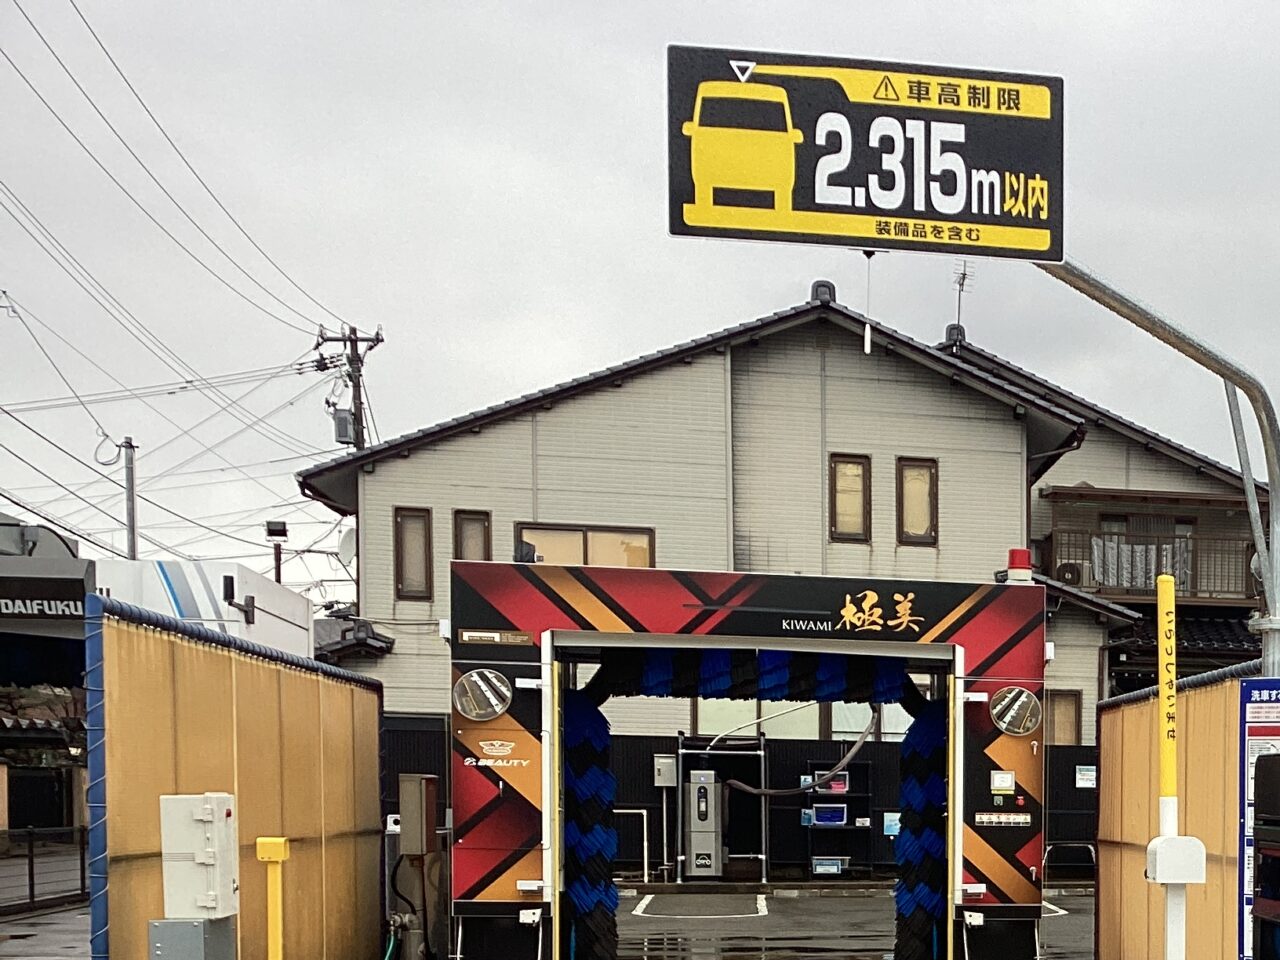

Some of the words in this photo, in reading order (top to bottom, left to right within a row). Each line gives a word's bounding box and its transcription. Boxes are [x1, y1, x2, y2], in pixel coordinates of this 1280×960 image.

[907, 79, 1021, 112] 車高制限
[875, 220, 980, 242] 装備品を含む
[0, 599, 84, 616] DAIFUKU
[782, 619, 832, 632] KIWAMI
[1165, 610, 1176, 741] いらっしゃいませ
[477, 758, 530, 767] BEAUTY
